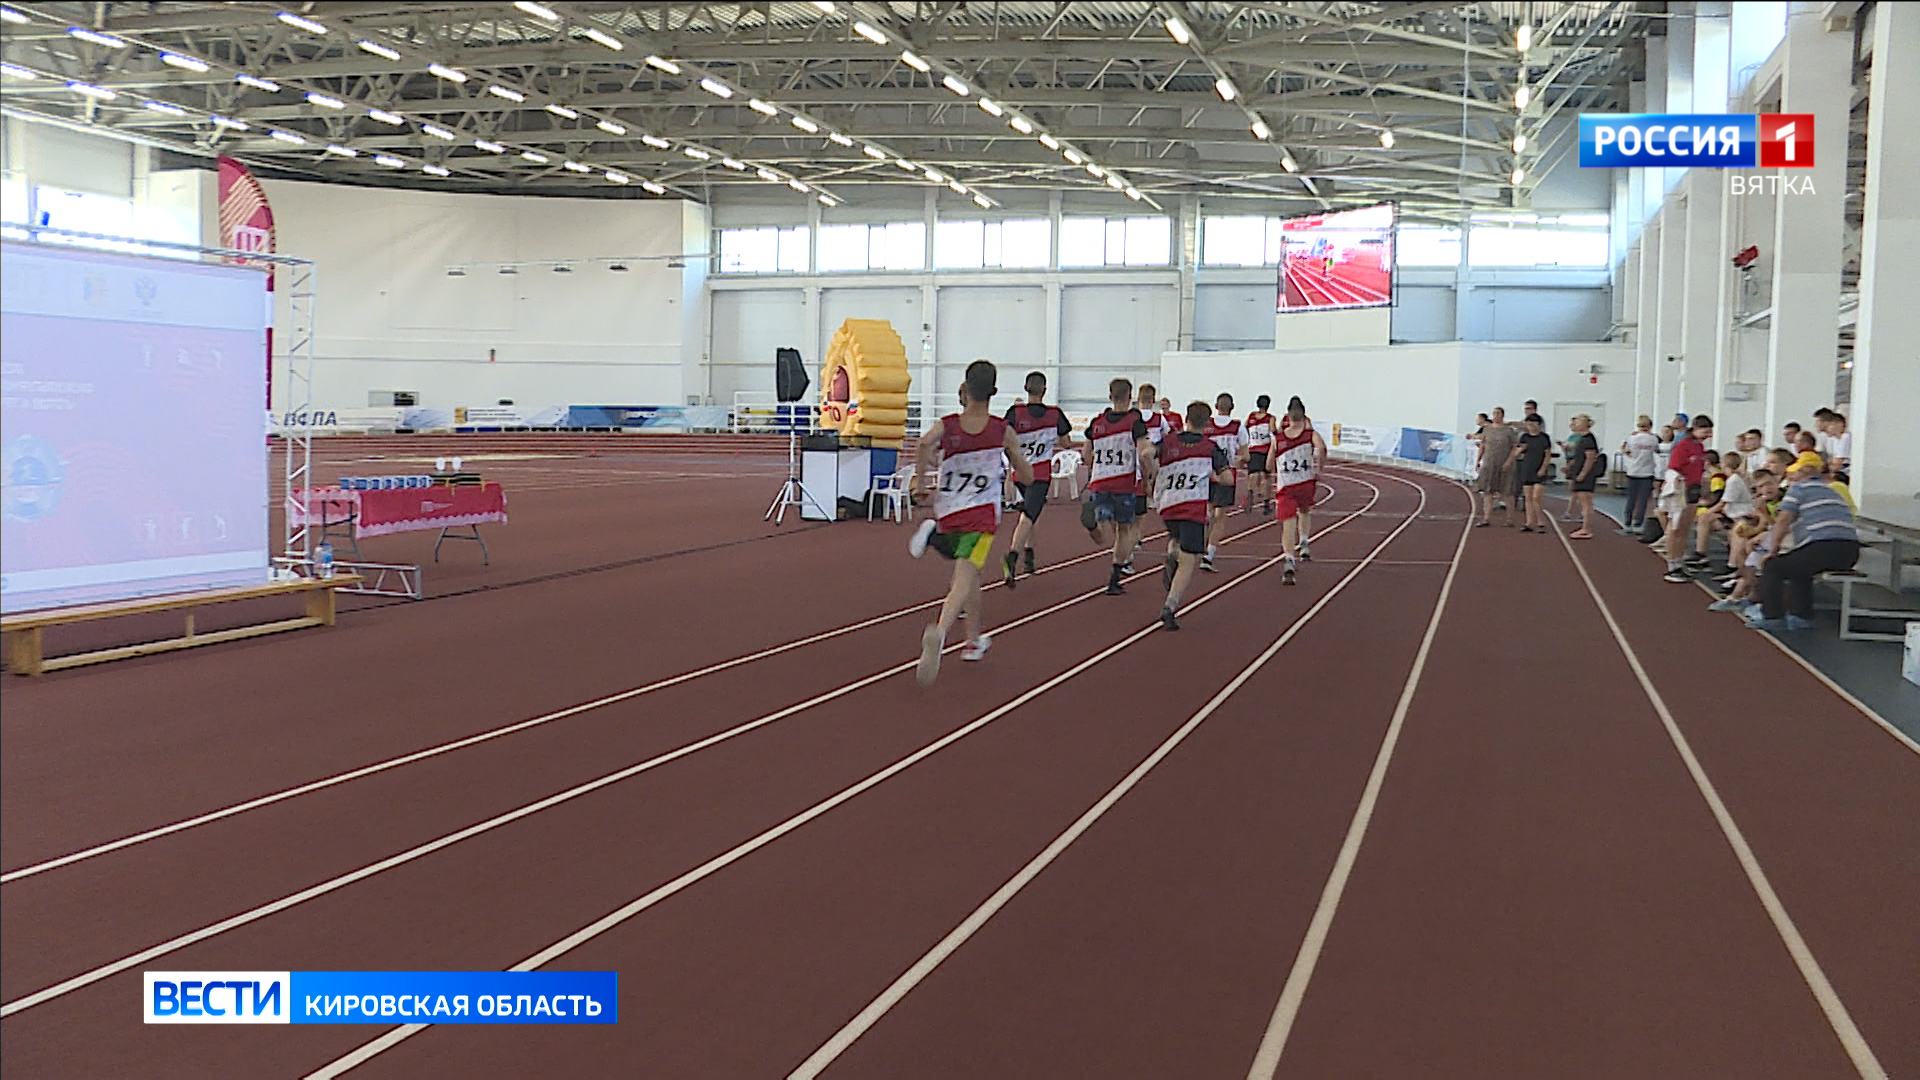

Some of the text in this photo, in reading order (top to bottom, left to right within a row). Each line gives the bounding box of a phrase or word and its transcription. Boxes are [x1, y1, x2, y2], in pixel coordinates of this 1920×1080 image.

[1095, 449, 1124, 466] 151
[1283, 459, 1309, 473] 124
[940, 471, 989, 494] 179
[1166, 473, 1199, 490] 185
